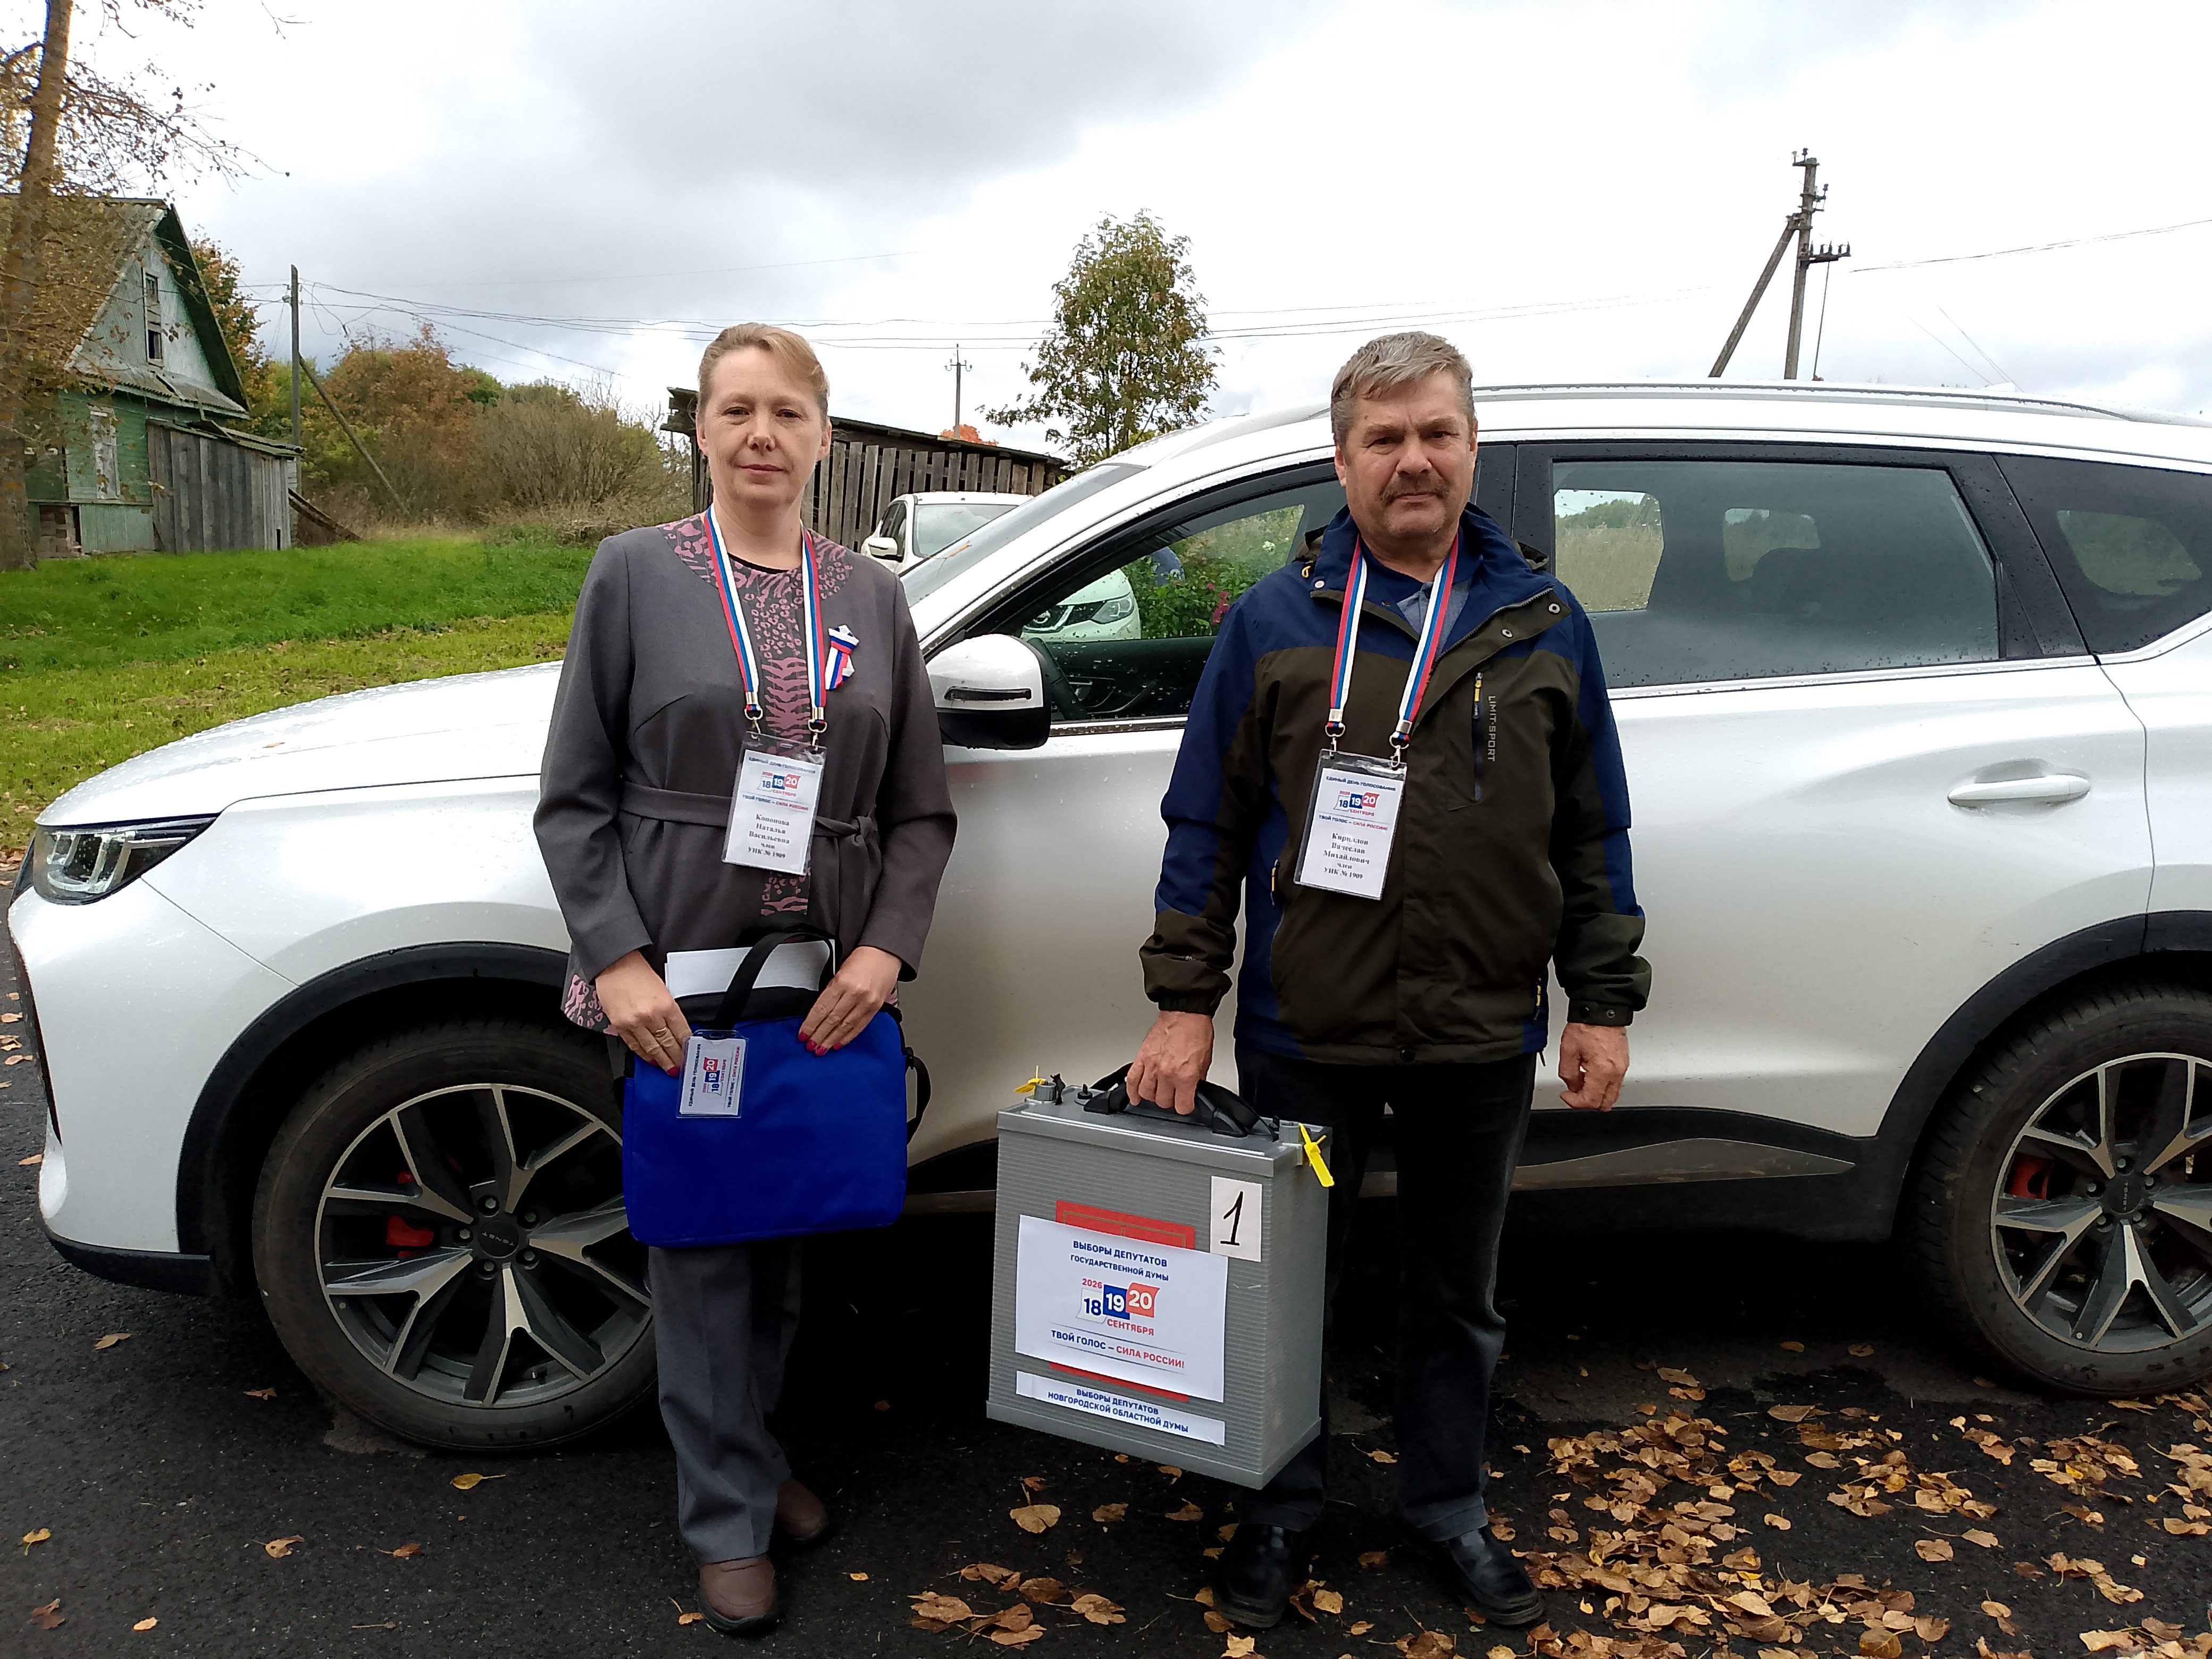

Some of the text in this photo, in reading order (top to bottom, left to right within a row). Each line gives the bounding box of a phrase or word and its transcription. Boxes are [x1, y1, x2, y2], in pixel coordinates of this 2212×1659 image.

[1488, 696, 1496, 761] LIMIT-SPORT
[774, 778, 783, 786] 19
[785, 777, 797, 786] 20
[1339, 795, 1376, 808] 18 19 20
[749, 831, 790, 844] Васильевна
[756, 823, 786, 834] Наталья
[1332, 833, 1368, 845] Кириллов
[1323, 850, 1370, 865] Михайлович
[1331, 842, 1365, 854] Вячеслав
[706, 1060, 719, 1092] 18 19 20
[1220, 1191, 1243, 1246] 1
[1073, 1241, 1167, 1267] ВЫБОРЫ ДЕПУТАТОВ
[1070, 1254, 1169, 1281] ГОСУДАРСТВЕННОЙ ДУМЫ
[1082, 1278, 1102, 1289] 2026
[1084, 1289, 1152, 1316] 18 19 20
[1107, 1319, 1154, 1336] СЕНТЯБРЯ
[1051, 1330, 1074, 1342] ТВОЙ
[1077, 1336, 1106, 1350] ГОЛОС
[1116, 1346, 1141, 1358] СИЛА
[1143, 1352, 1184, 1368] РОССИИ!
[1048, 1392, 1188, 1432] НОВГОРОДСКОЙ ОБЛАСТНОЙ ДУМЫ
[1076, 1389, 1159, 1414] ВЫБОРЫ ДЕПУТАТОВ
